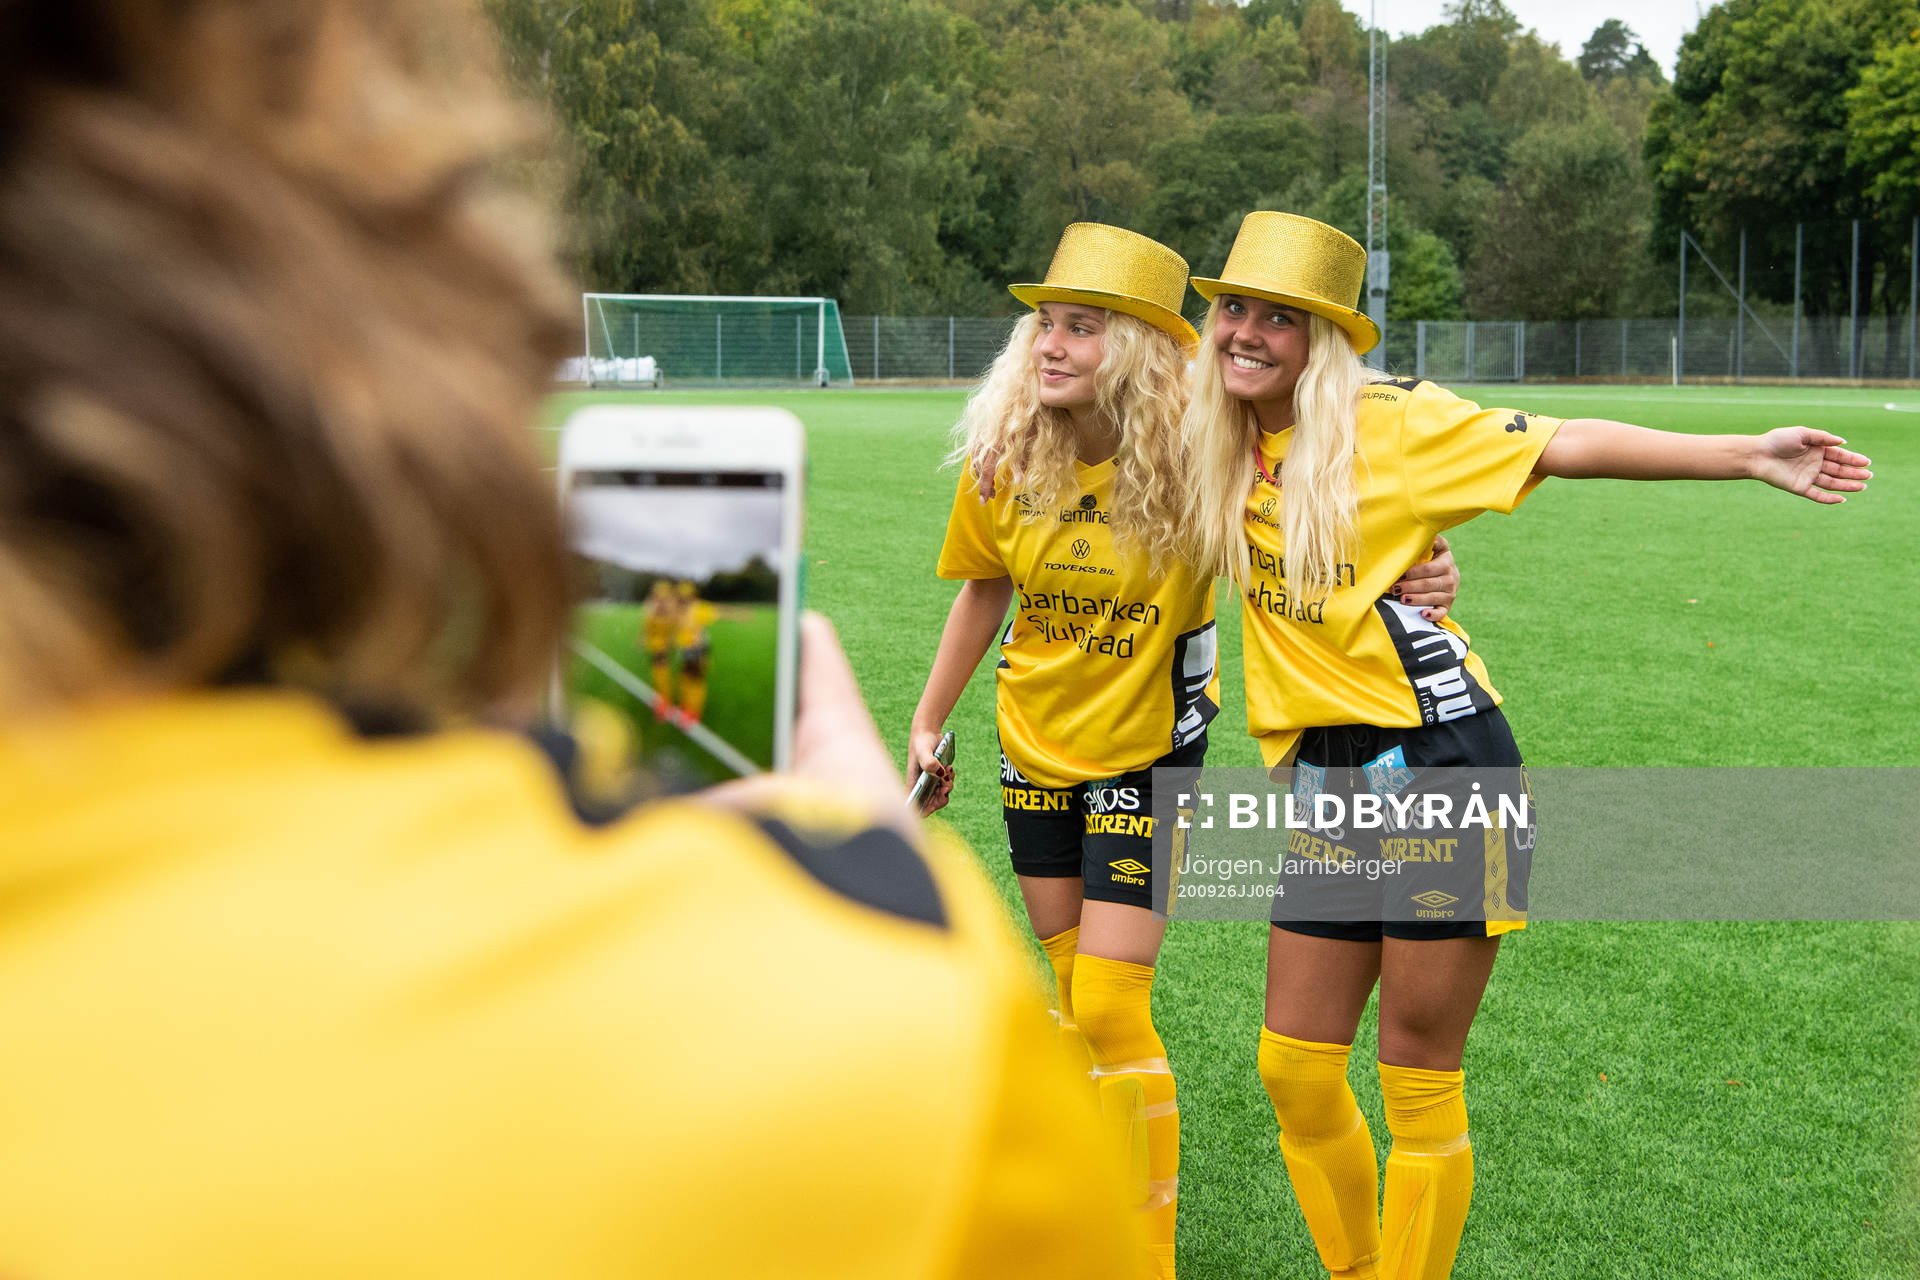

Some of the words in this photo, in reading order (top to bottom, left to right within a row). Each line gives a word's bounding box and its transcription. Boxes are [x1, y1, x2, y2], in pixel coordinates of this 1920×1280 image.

[1043, 562, 1097, 575] TOVEKS
[1098, 567, 1116, 576] BIL
[1288, 829, 1357, 869] IRENT
[1111, 873, 1146, 887] umbro
[1415, 908, 1455, 919] umbro
